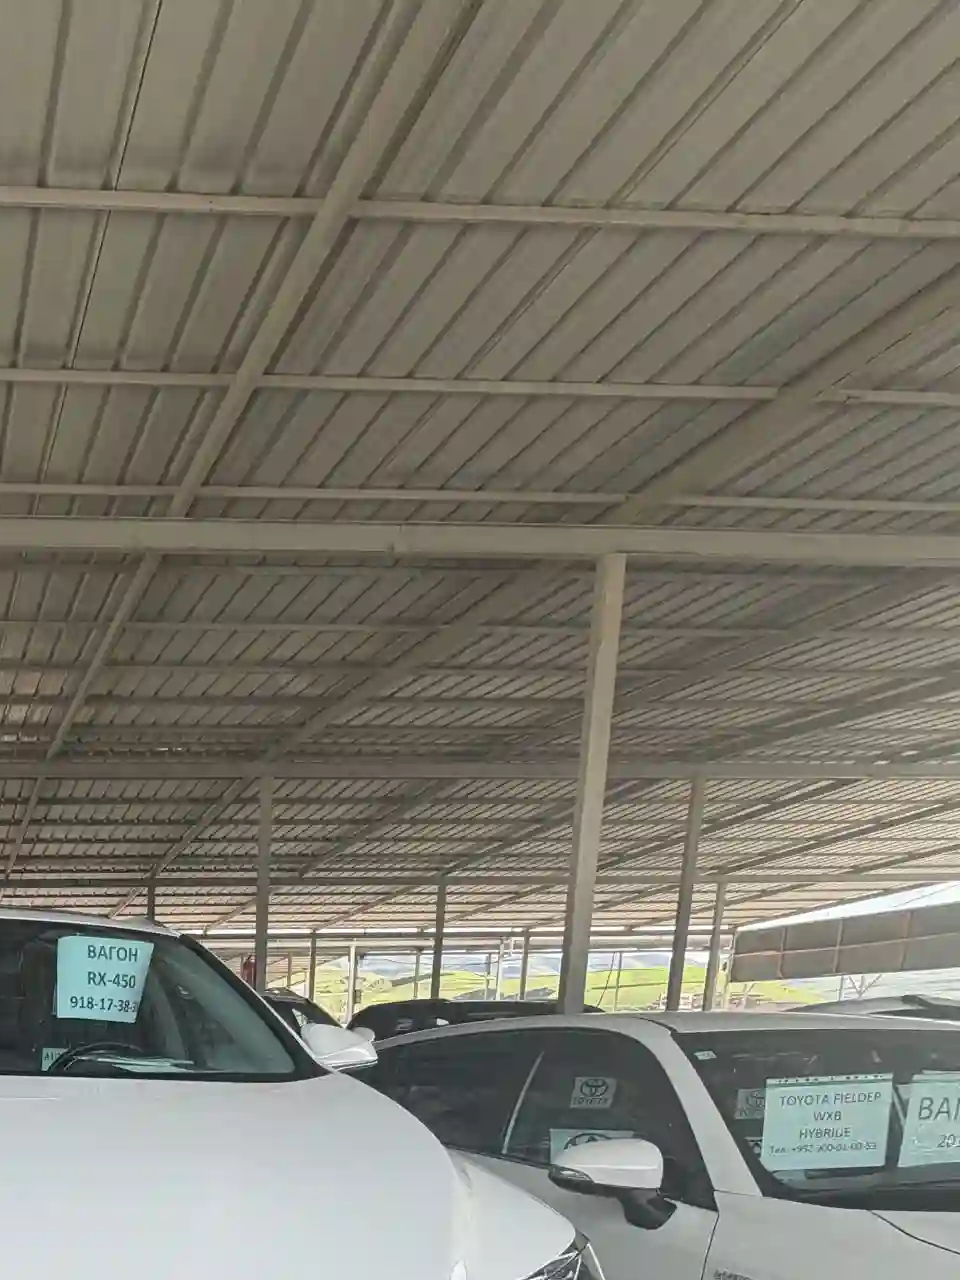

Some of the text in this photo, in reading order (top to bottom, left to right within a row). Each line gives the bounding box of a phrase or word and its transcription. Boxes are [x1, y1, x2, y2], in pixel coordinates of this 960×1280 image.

[87, 944, 138, 962] ВАГОН
[87, 970, 136, 989] RX-450
[780, 1094, 831, 1106] TOYOTA
